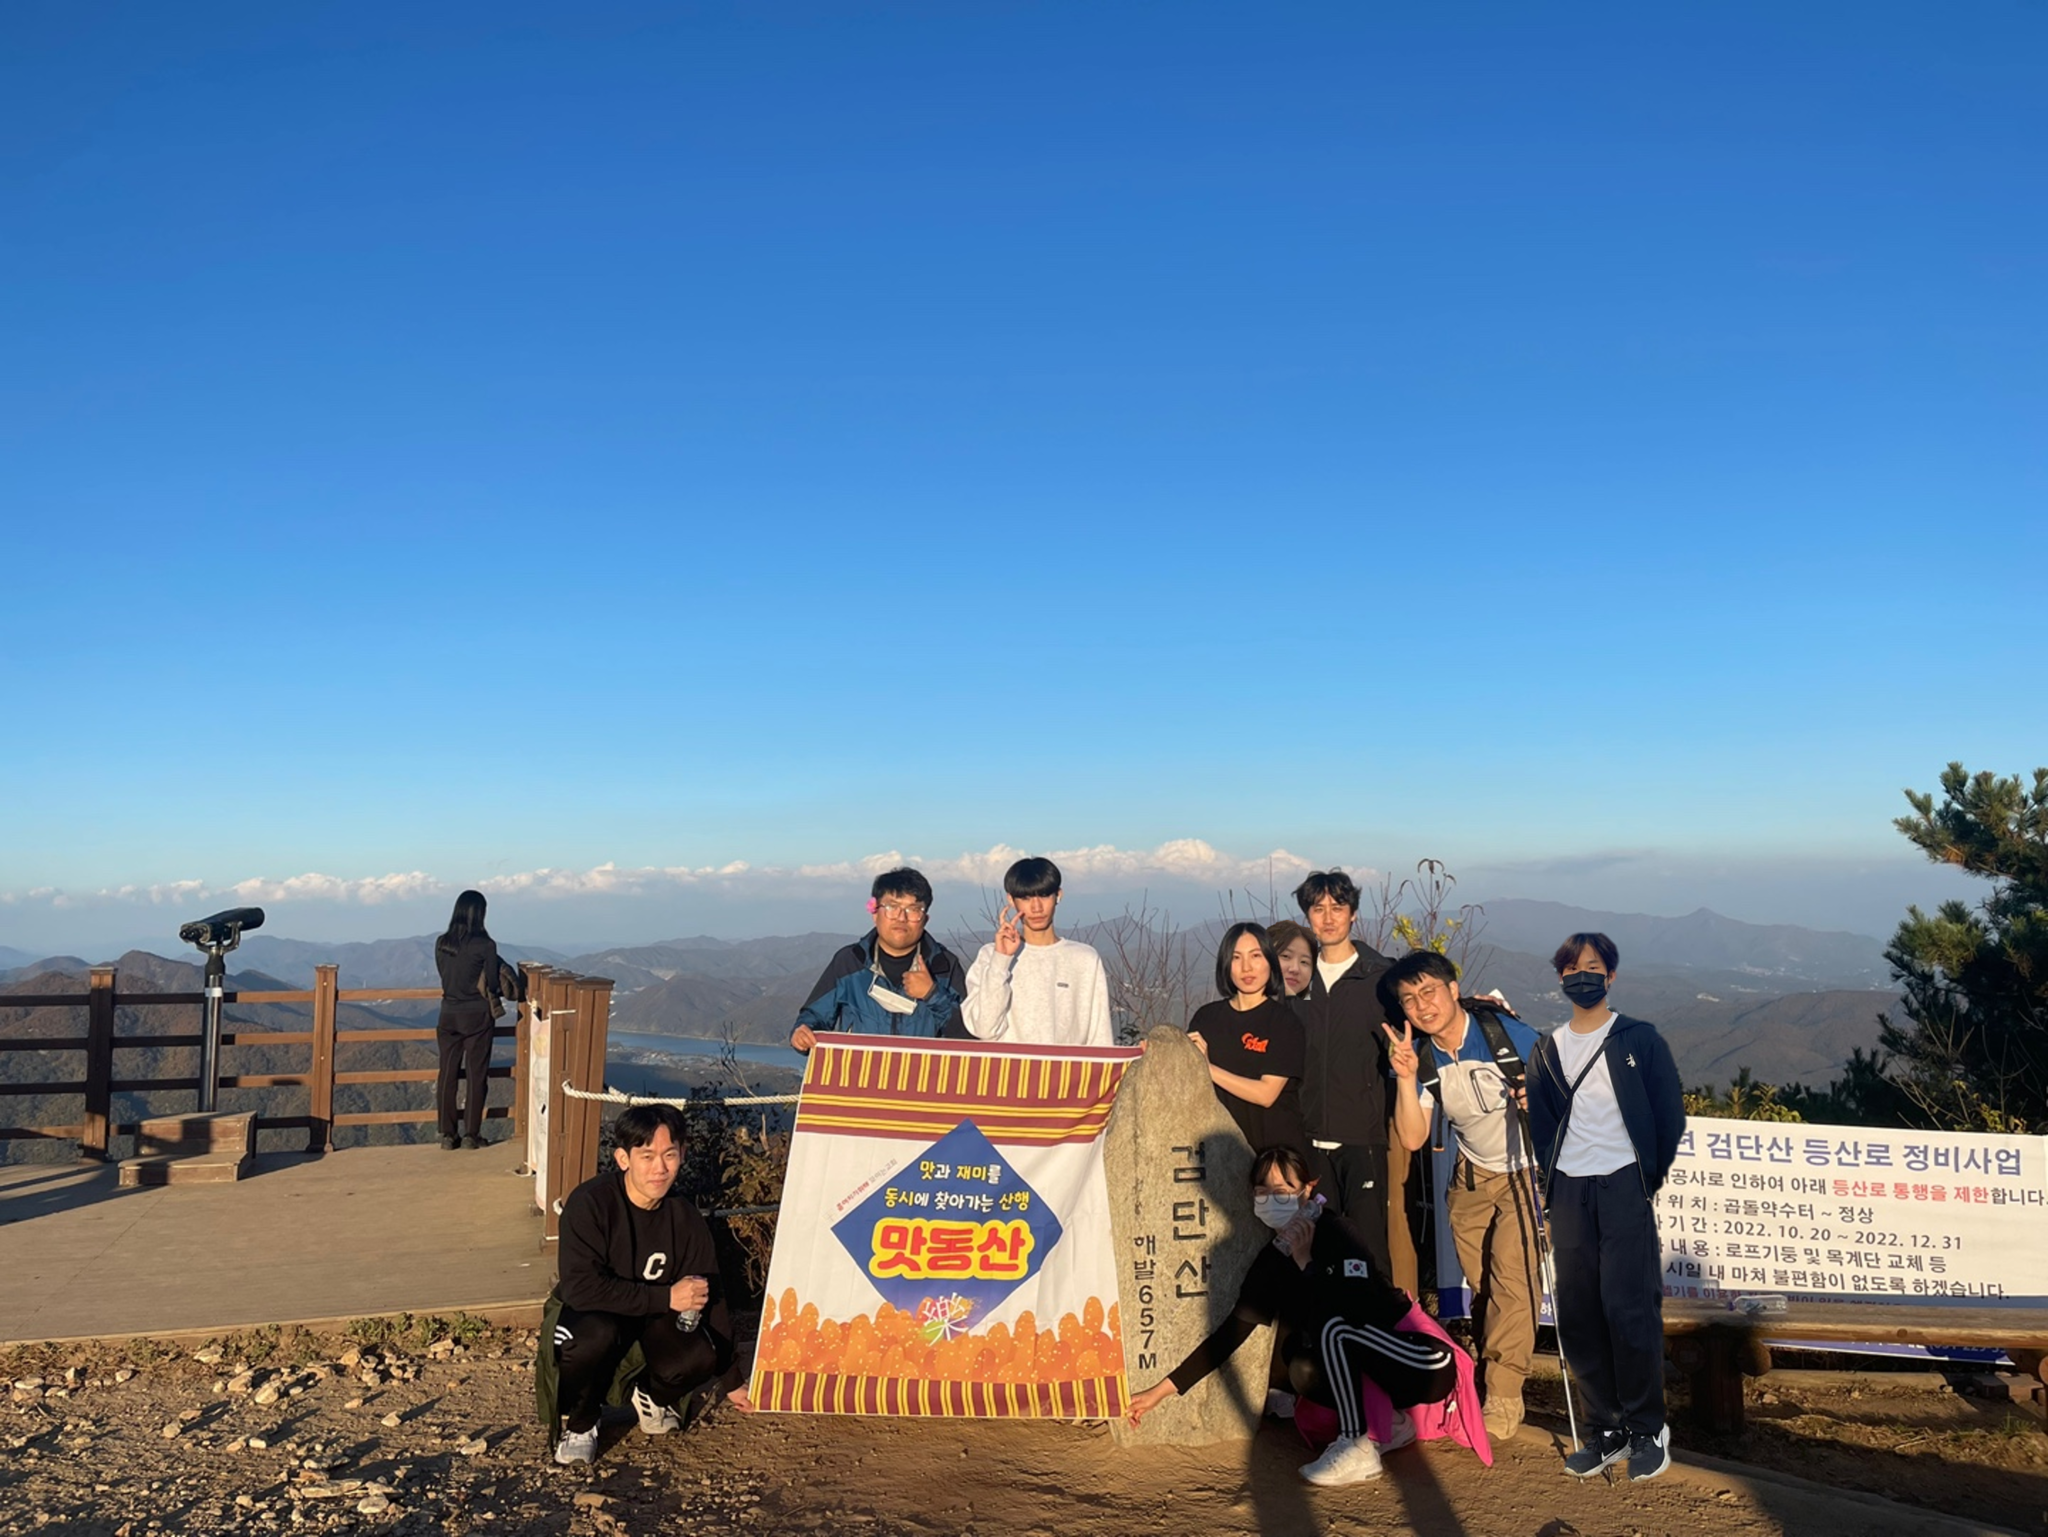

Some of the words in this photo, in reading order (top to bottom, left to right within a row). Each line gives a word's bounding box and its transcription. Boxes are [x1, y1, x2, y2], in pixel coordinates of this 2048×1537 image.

[1707, 1133, 1793, 1163] 검단산
[1803, 1139, 1893, 1168] 등산로
[1902, 1145, 2022, 1176] 정비사업
[920, 1160, 951, 1180] 맛과
[956, 1163, 1002, 1185] 재미를
[884, 1187, 930, 1208] 동시에
[934, 1191, 994, 1213] 찾아가는
[999, 1191, 1030, 1211] 산행
[1730, 1173, 1784, 1192] 인하여
[1791, 1177, 1827, 1195] 아래
[1832, 1179, 1887, 1197] 등산로
[1893, 1183, 1947, 1202] 통행을
[1172, 1141, 1212, 1298] 검단산
[1724, 1198, 1814, 1220] 곱돌약수터
[1839, 1206, 1874, 1224] 정상
[874, 1221, 1030, 1275] 맛동산
[1810, 1228, 1831, 1241] 20
[1942, 1236, 1962, 1250] 31
[643, 1252, 666, 1280] C
[1726, 1243, 1798, 1264] 로프기둥
[1803, 1248, 1821, 1265] 및
[1826, 1249, 1881, 1269] 목계단
[1887, 1254, 1924, 1272] 교체
[1929, 1256, 1947, 1273] 등
[1666, 1261, 1700, 1278] 시일
[1709, 1265, 1725, 1281] 내
[1732, 1267, 1766, 1284] 마쳐
[1773, 1269, 1846, 1290] 불편함이
[1851, 1275, 1906, 1295] 없도록
[1912, 1279, 2010, 1300] 하겠습니다.
